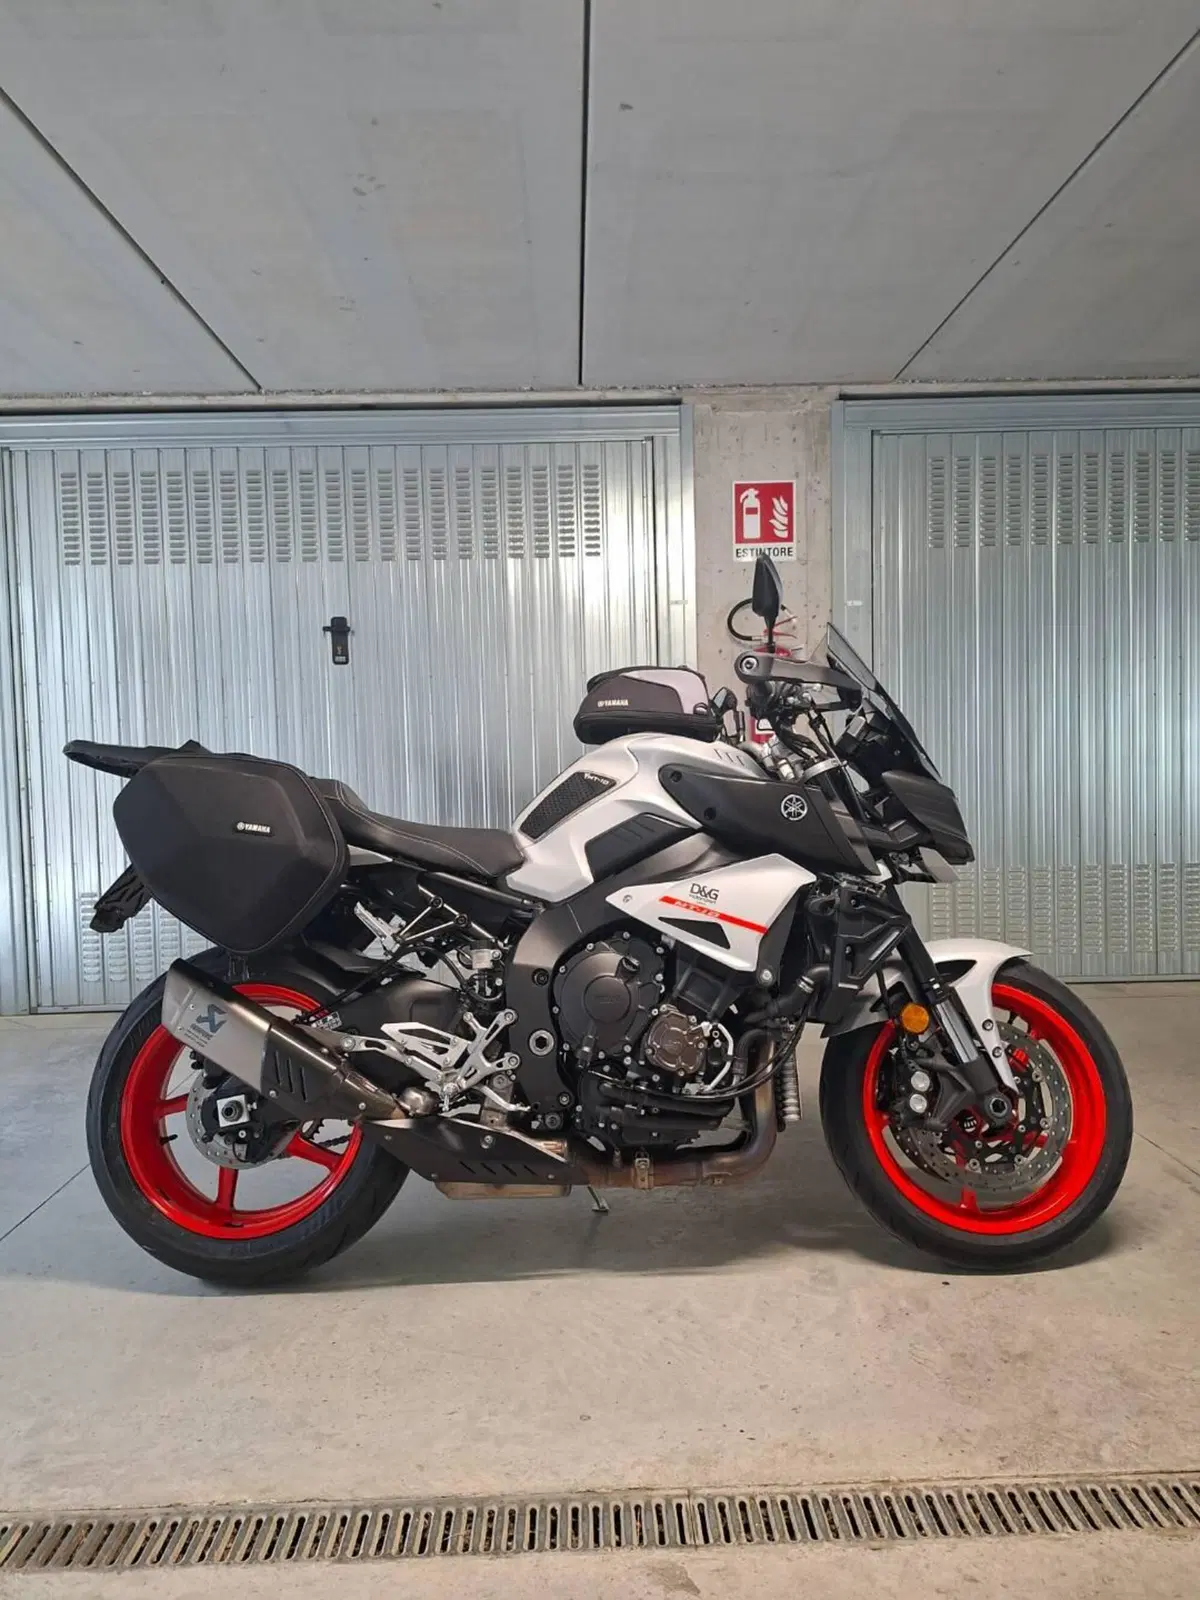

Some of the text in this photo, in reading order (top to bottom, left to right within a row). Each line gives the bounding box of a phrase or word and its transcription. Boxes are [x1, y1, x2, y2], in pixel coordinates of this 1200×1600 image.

[735, 547, 794, 558] ESTINTORE
[245, 823, 270, 833] YAMAHA
[690, 883, 719, 900] D&G
